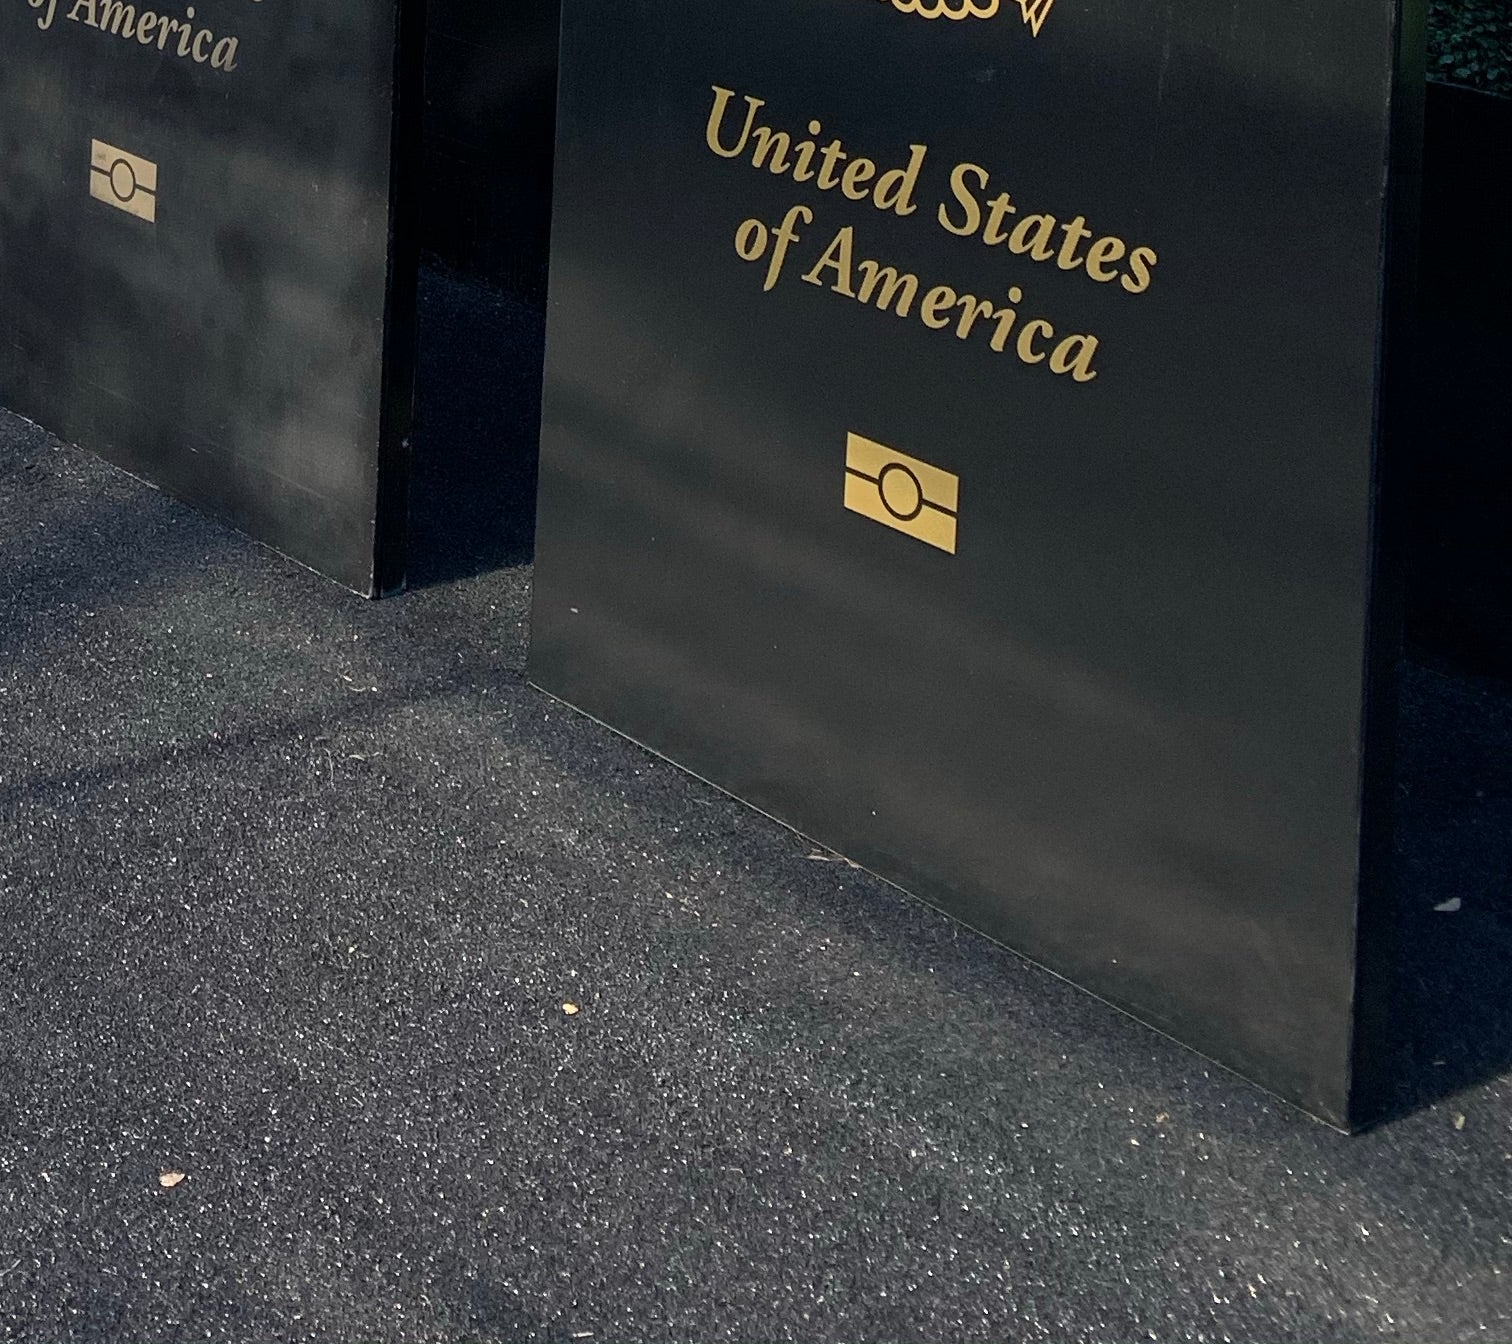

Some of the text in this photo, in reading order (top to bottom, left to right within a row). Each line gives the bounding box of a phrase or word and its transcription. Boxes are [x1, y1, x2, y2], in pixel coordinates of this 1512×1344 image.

[705, 84, 1158, 295] United States
[734, 204, 1100, 383] of America
